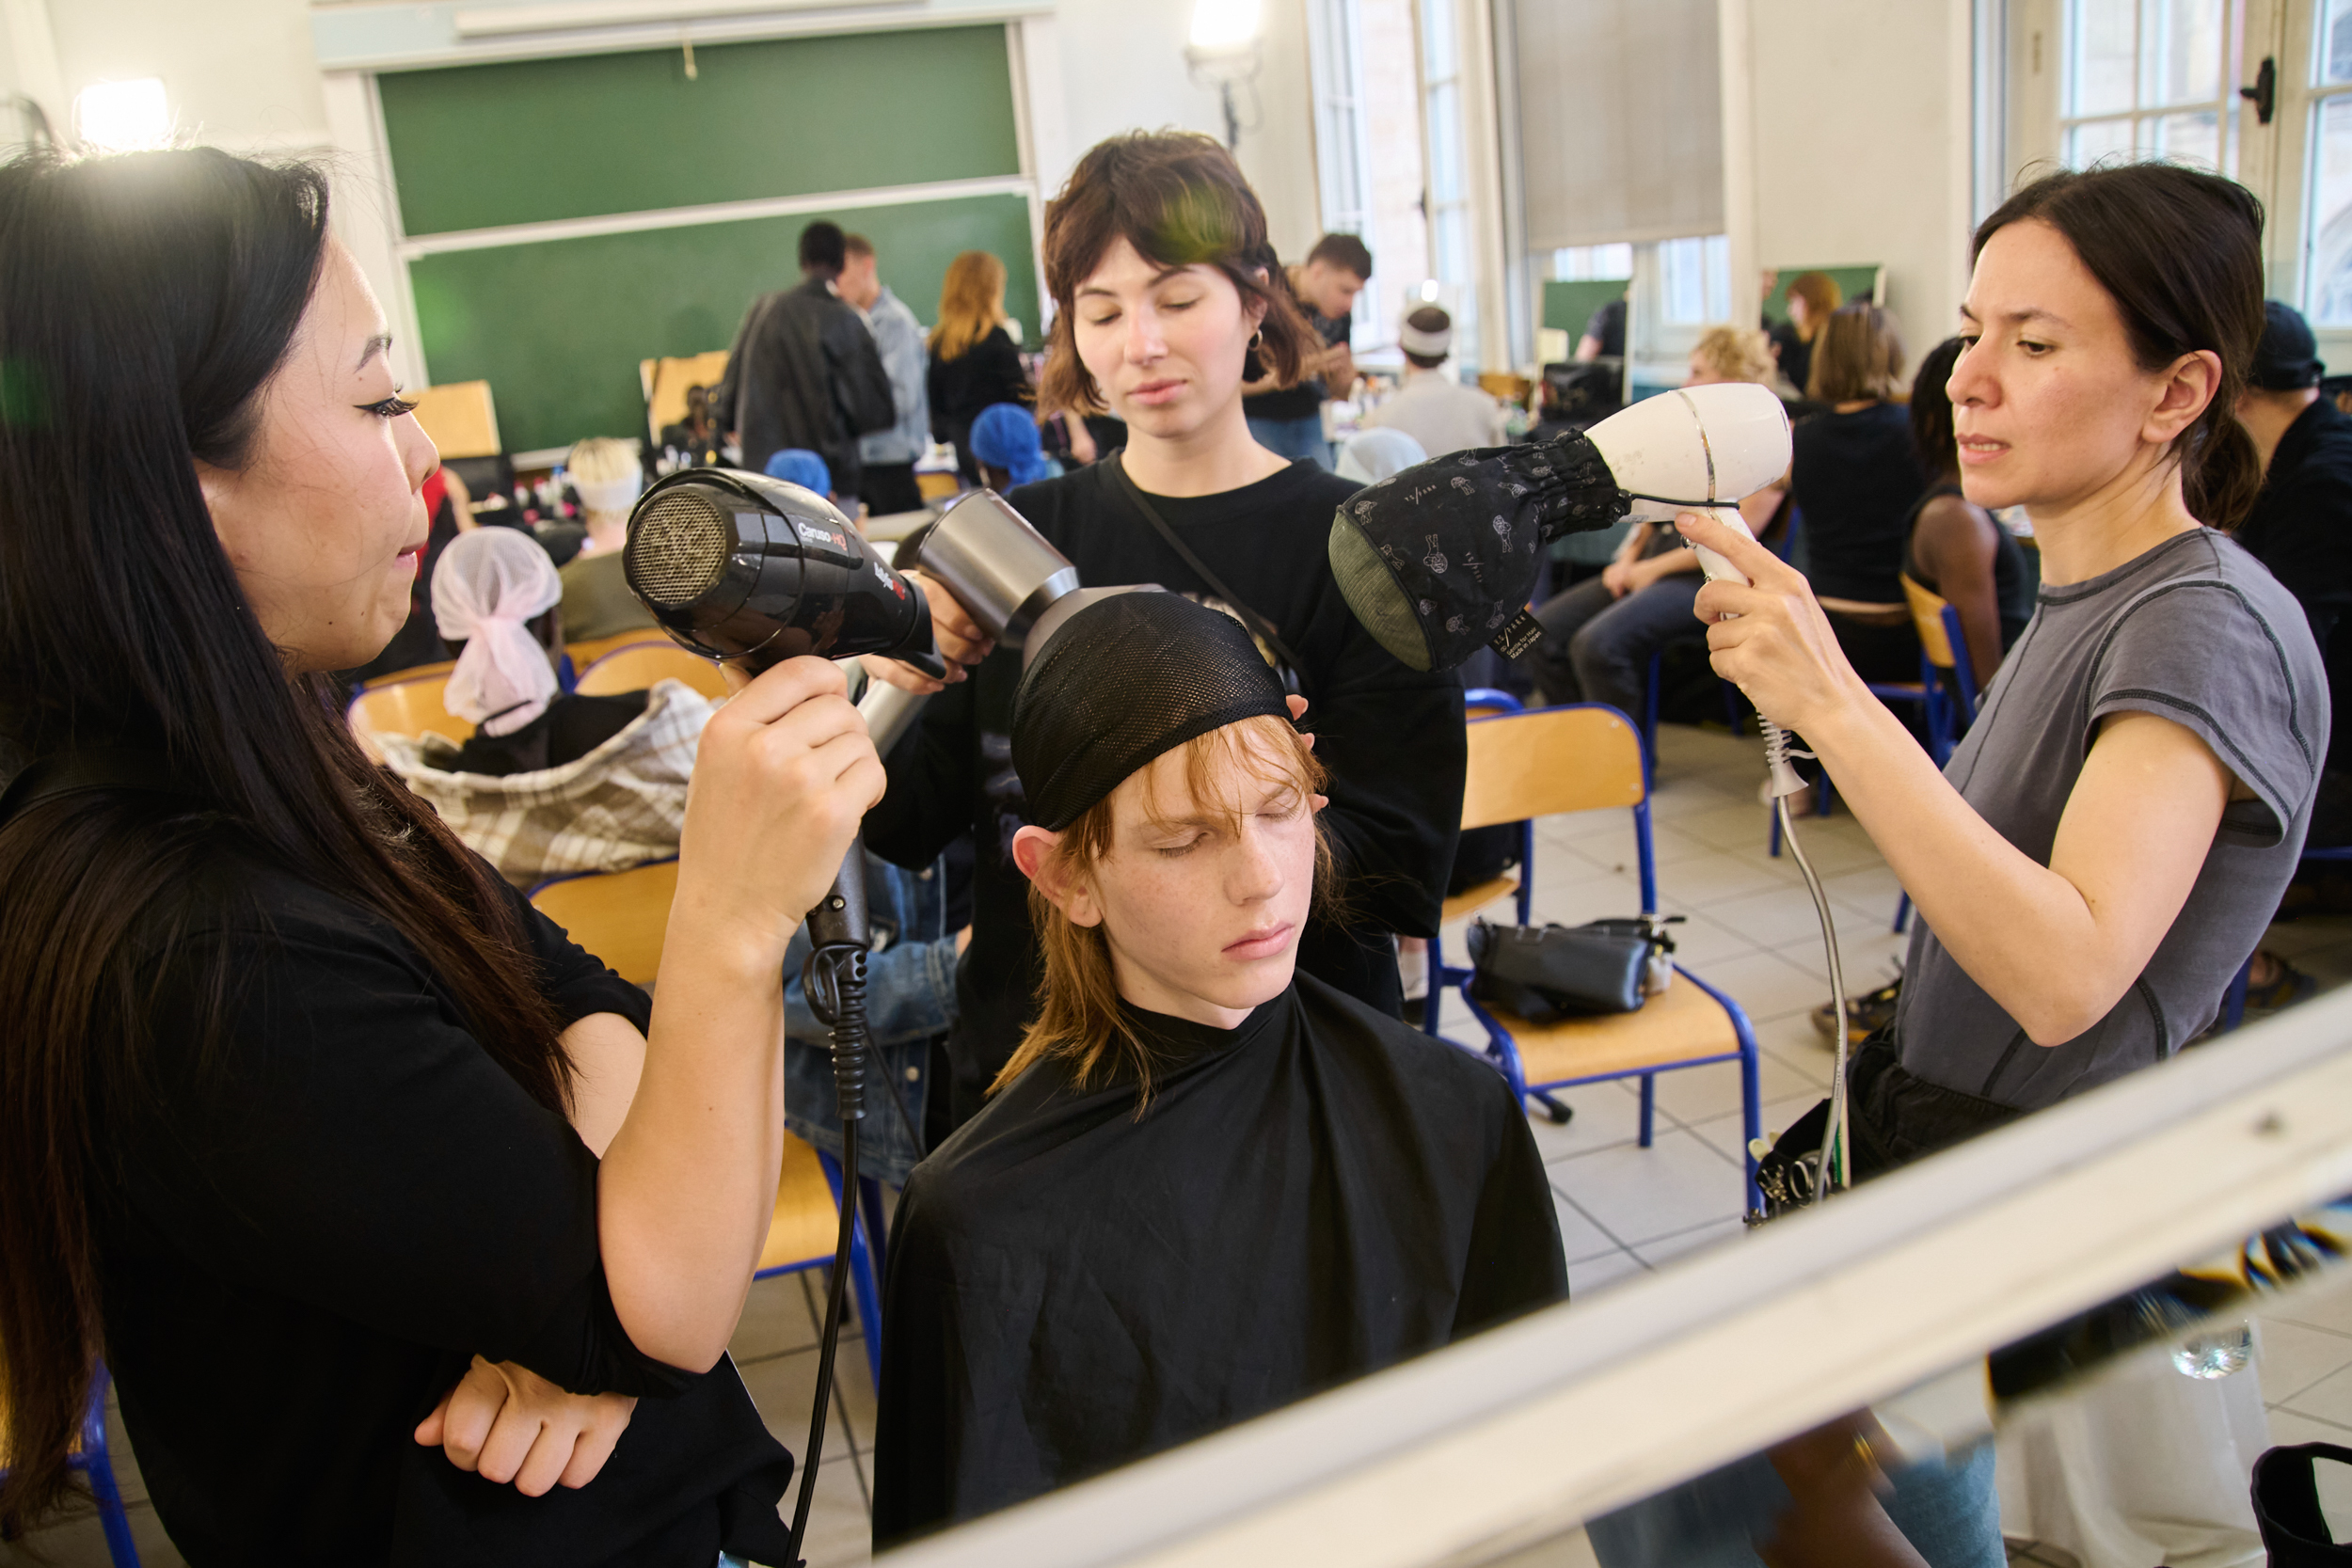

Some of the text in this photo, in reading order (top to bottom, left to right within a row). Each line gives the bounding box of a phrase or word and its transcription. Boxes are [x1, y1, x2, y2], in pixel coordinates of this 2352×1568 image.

[1506, 626, 1536, 656] Gentle for Hair
[1510, 647, 1523, 658] Made
[1527, 631, 1541, 644] Japan
